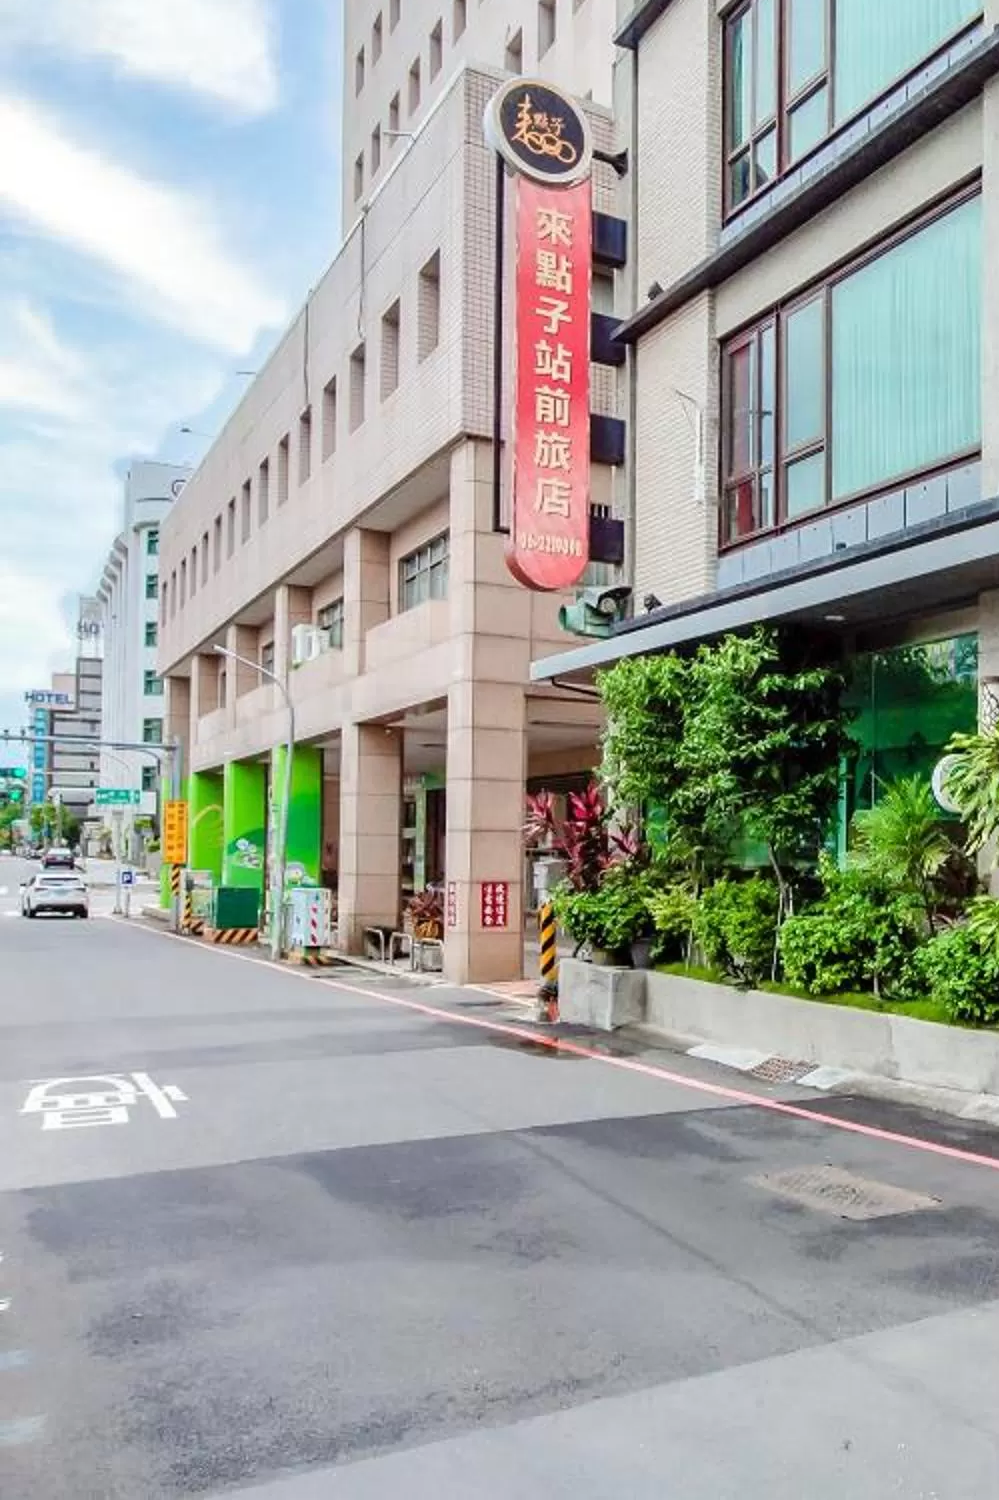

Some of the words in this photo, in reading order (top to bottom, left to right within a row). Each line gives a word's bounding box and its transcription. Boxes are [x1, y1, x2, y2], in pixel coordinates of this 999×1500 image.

[533, 206, 573, 518] 來點子站前旅店
[25, 691, 73, 704] HOTEL
